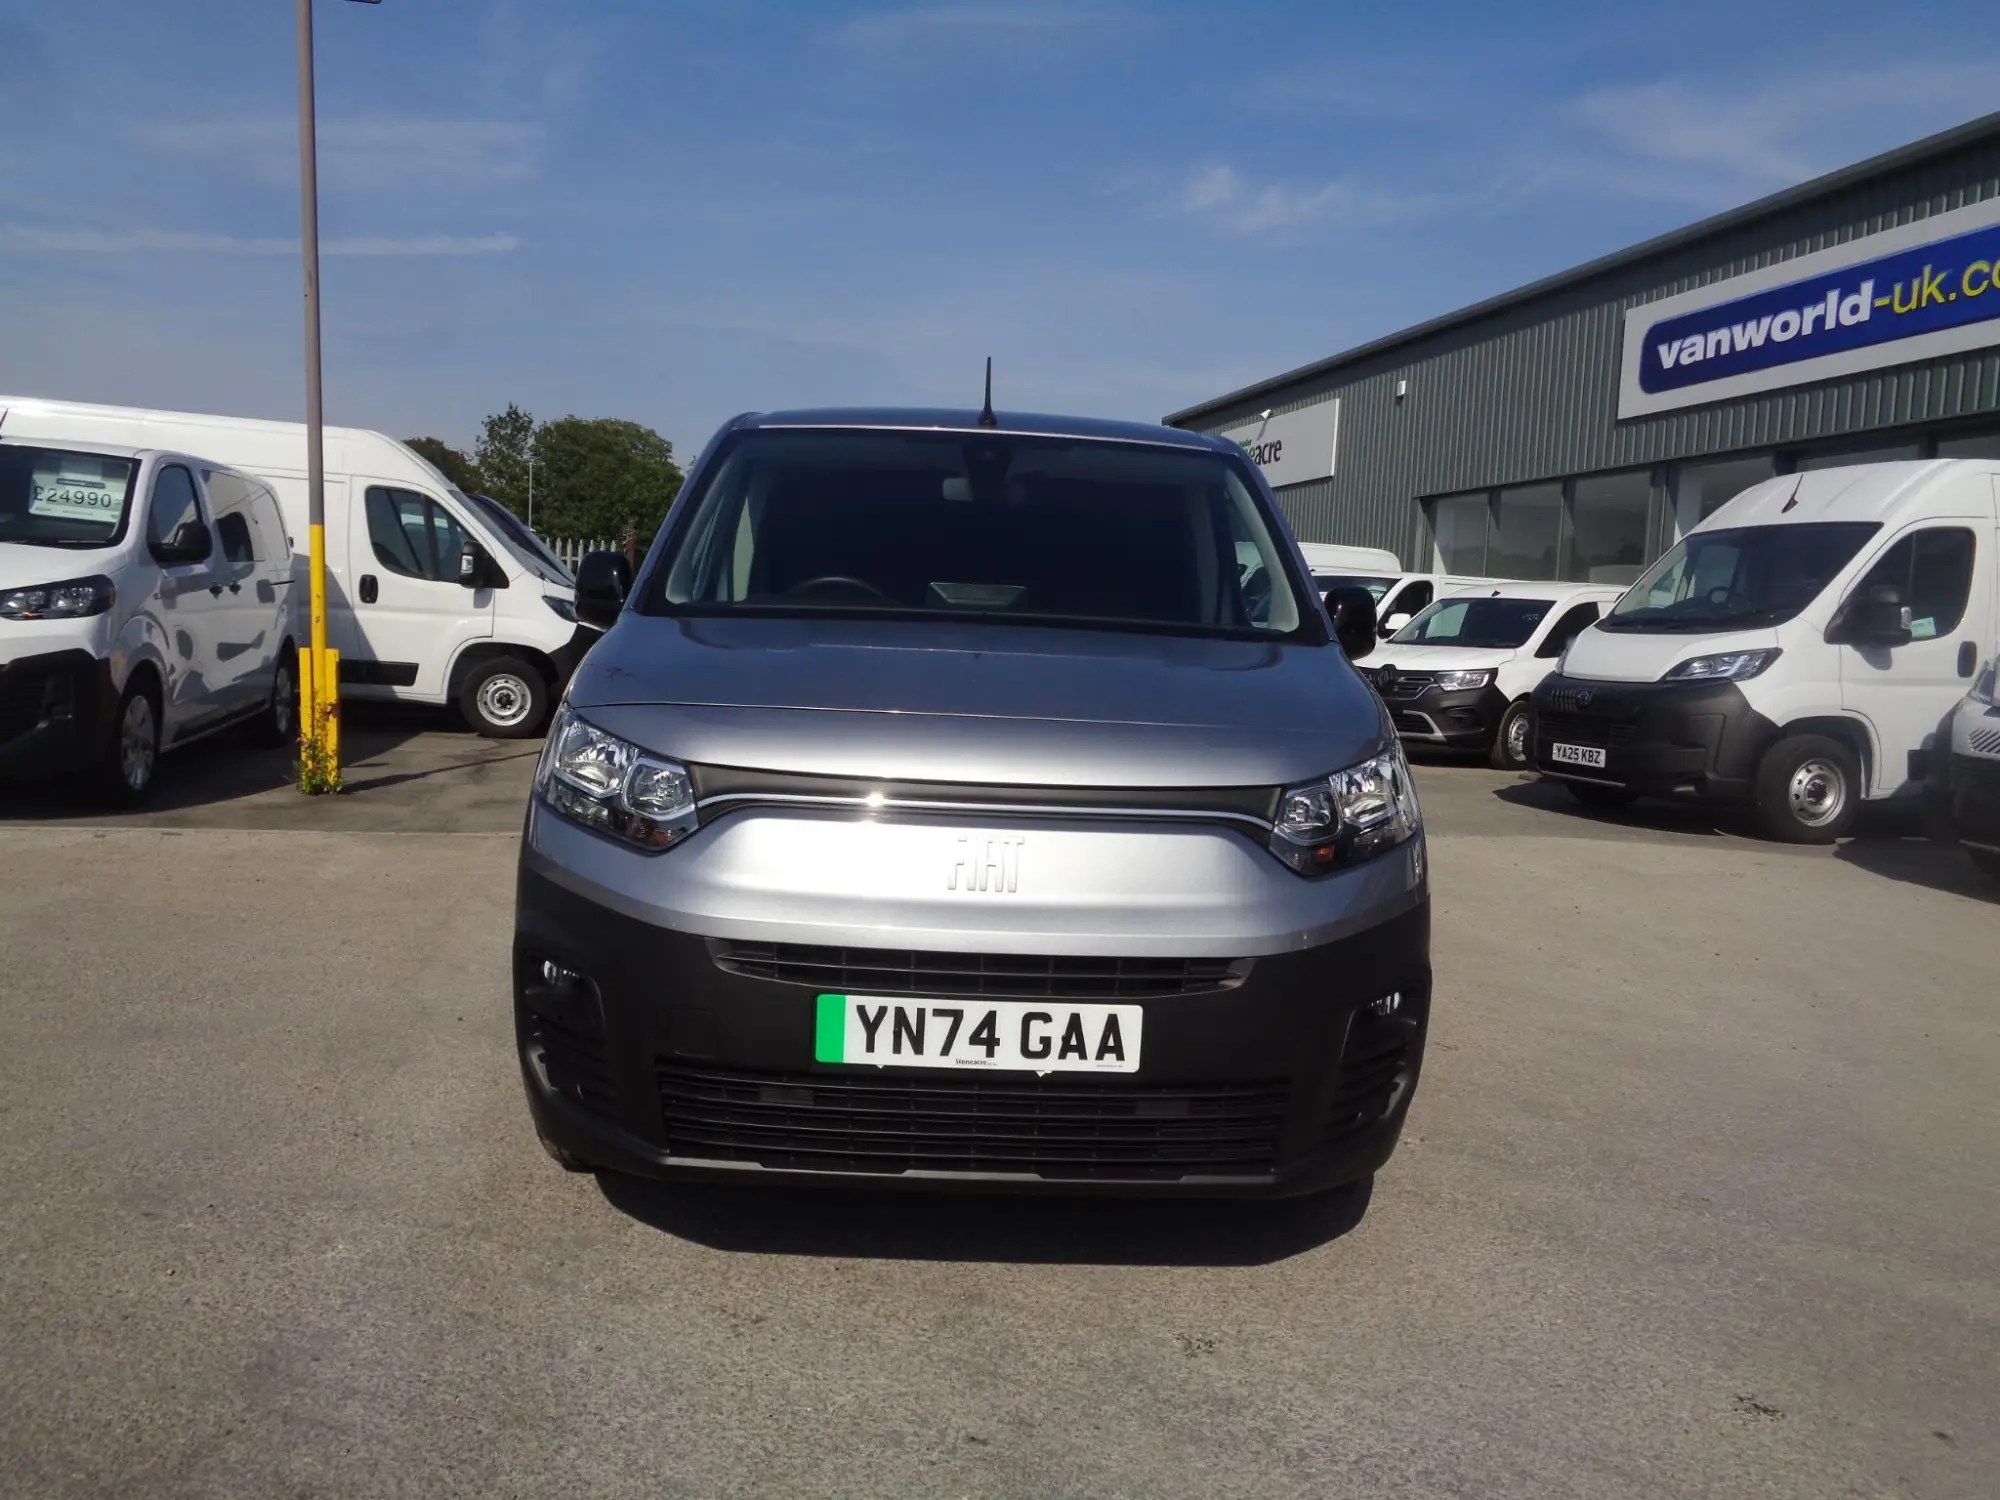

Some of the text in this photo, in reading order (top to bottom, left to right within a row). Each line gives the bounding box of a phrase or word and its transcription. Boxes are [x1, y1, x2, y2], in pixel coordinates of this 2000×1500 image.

[1657, 256, 2000, 370] vanworld-uk.c
[34, 485, 111, 508] £24990
[1556, 745, 1601, 764] YA25 KBZ
[856, 1004, 1126, 1062] YN74 GAA
